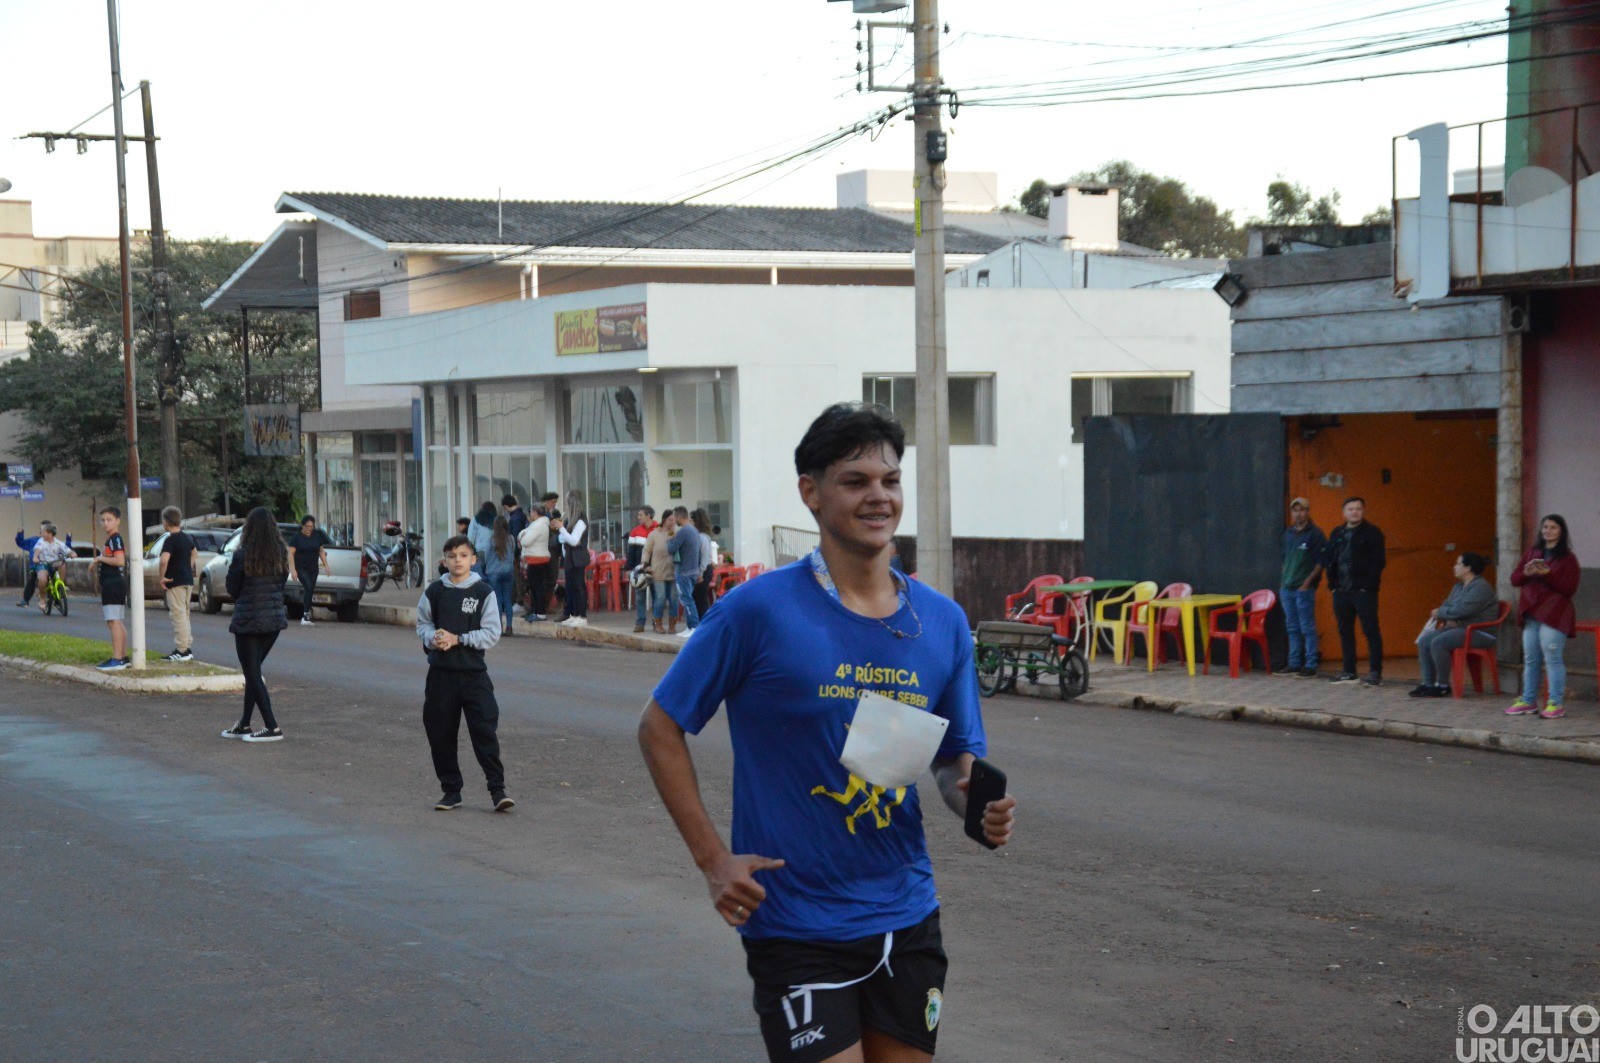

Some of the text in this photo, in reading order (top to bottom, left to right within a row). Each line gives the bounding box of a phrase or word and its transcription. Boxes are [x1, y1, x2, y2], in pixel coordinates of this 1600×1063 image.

[855, 662, 920, 687] RÚSTICA
[819, 685, 855, 699] LIONS
[897, 692, 929, 708] SEBERI
